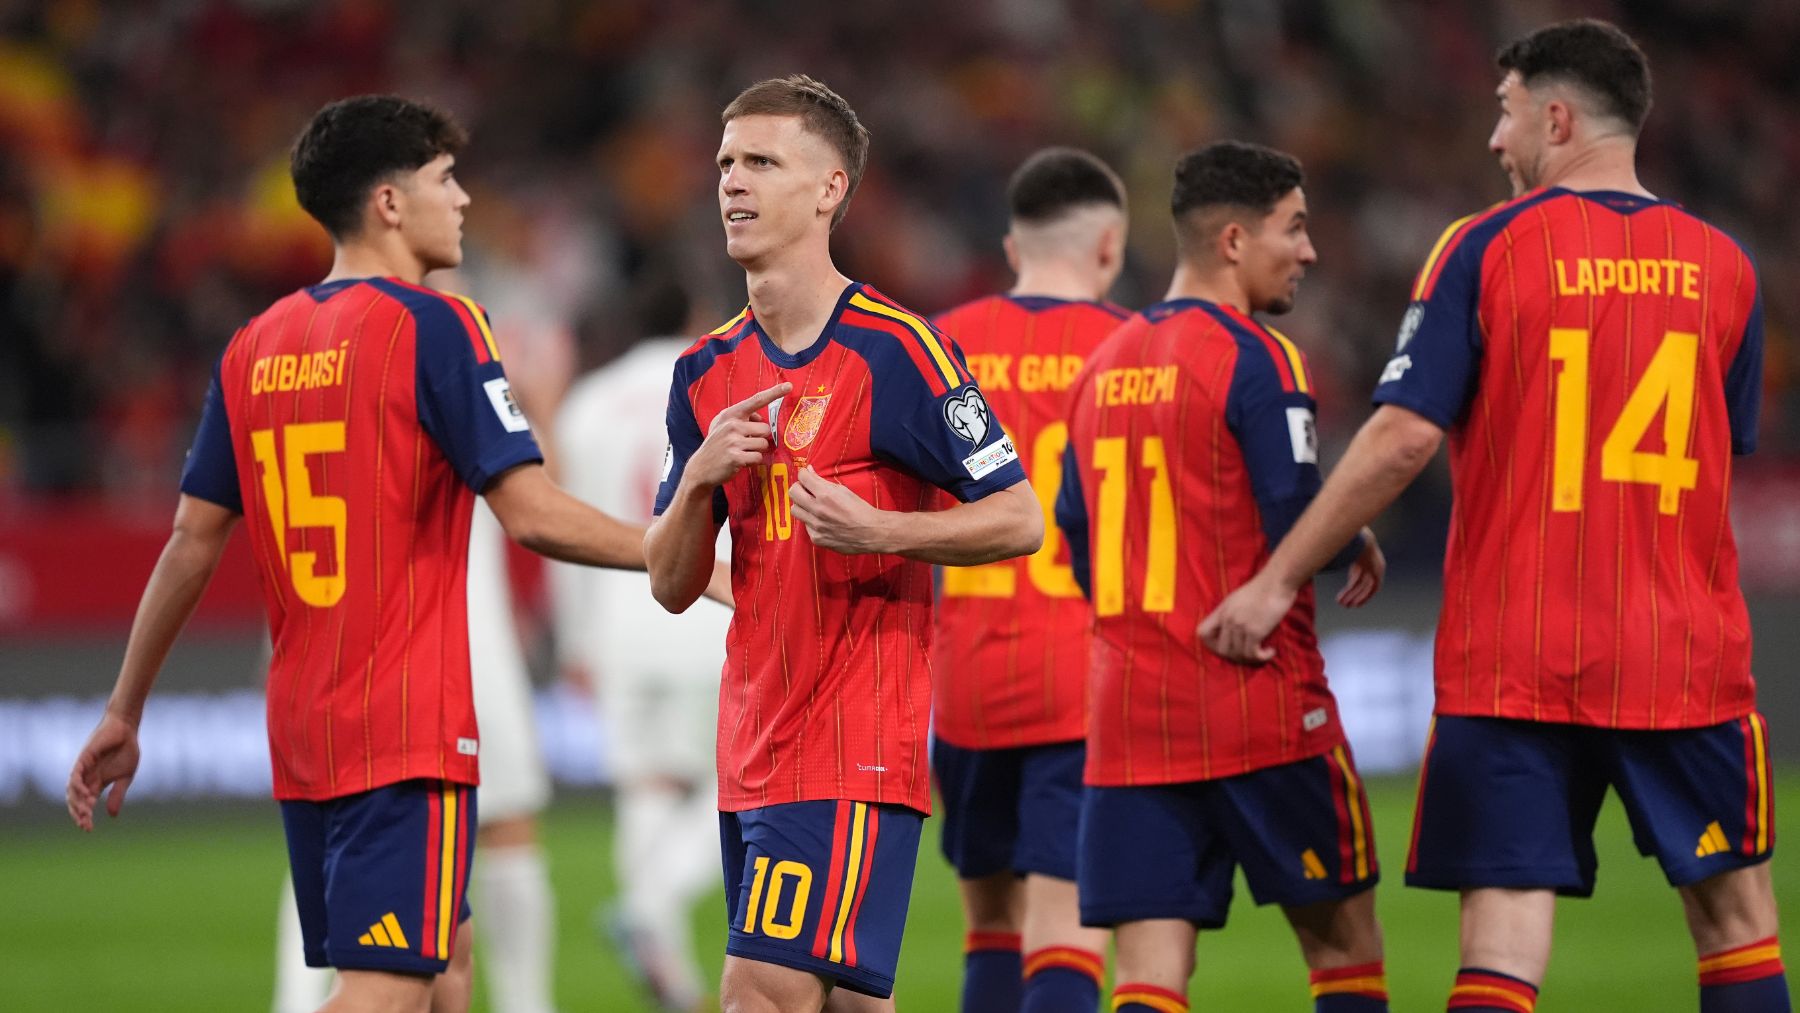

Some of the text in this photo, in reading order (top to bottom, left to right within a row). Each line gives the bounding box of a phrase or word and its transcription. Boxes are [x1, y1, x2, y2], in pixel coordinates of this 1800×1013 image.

[1555, 257, 1701, 300] LAPORTE
[251, 339, 350, 396] CUBARSÍ
[1095, 365, 1177, 409] YEREMI
[1549, 328, 1699, 516] 14
[251, 420, 347, 608] 15
[758, 463, 792, 542] 10
[1093, 437, 1177, 617] 11
[742, 856, 813, 940] 10
